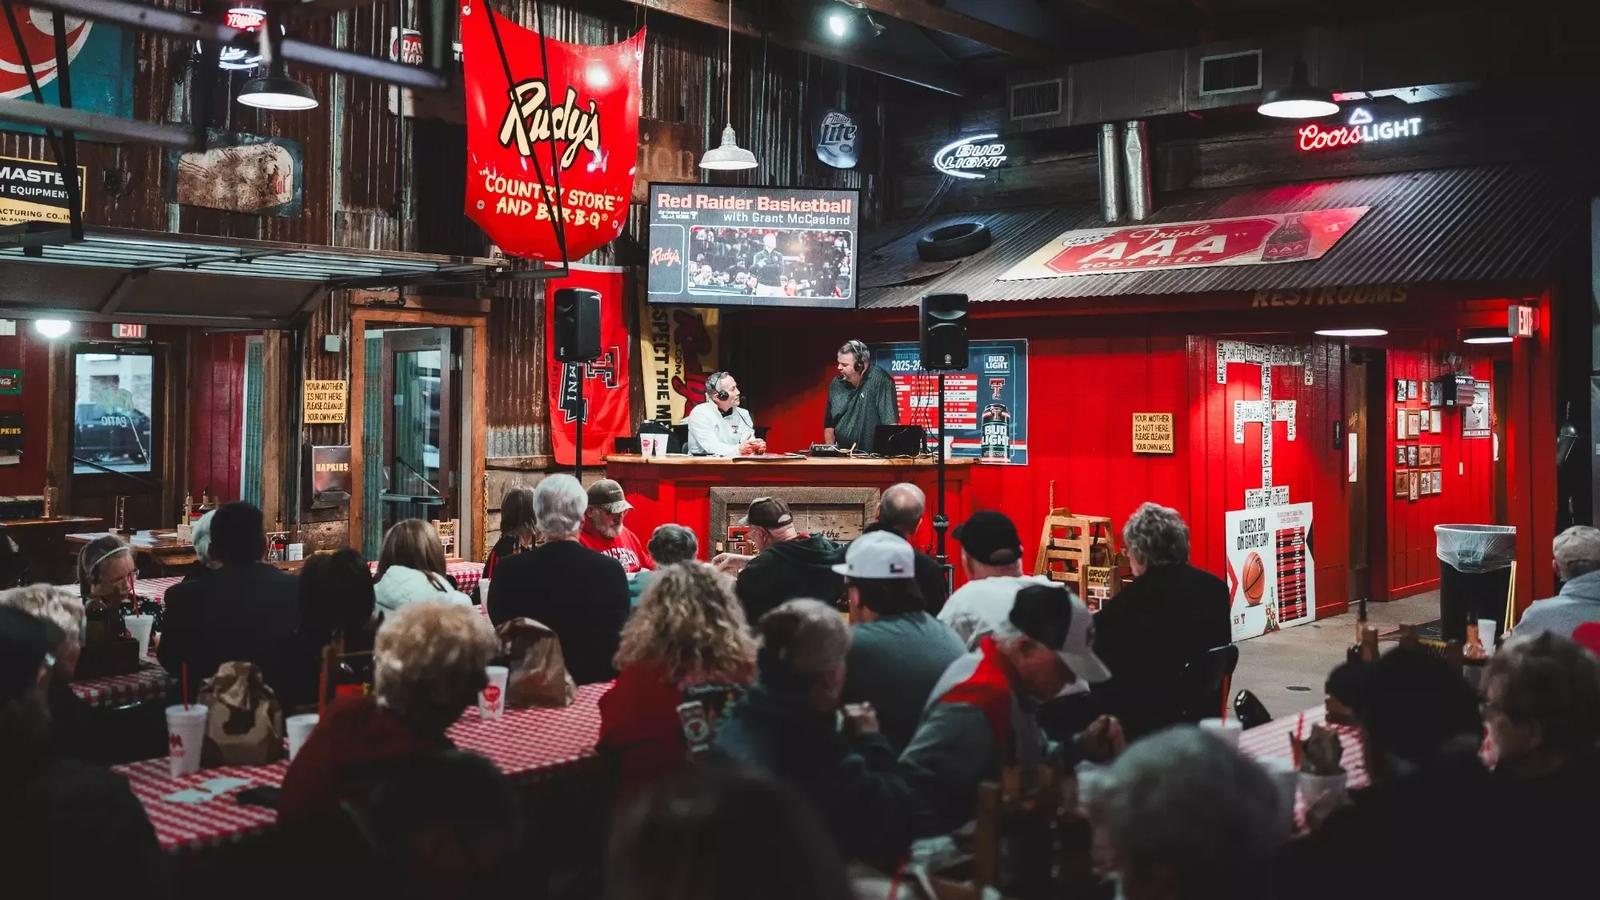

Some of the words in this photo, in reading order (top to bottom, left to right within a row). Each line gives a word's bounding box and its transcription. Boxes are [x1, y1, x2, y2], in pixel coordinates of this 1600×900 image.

[499, 80, 601, 169] Rudy's
[1299, 124, 1363, 151] Coors
[1362, 117, 1422, 142] LIGHT
[955, 144, 1006, 157] BUD
[943, 155, 1008, 169] LIGHT
[496, 196, 533, 217] AND
[657, 193, 692, 209] Red
[696, 194, 753, 210] Raider
[757, 196, 851, 213] Basketball
[723, 212, 749, 223] with
[752, 213, 784, 224] Grant
[787, 214, 850, 225] McCasland
[650, 247, 682, 267] Rudy's
[1146, 255, 1203, 267] BEER
[1251, 286, 1408, 308] RESTROOMS
[119, 323, 143, 337] EXIT
[985, 361, 1009, 369] LIGHT
[306, 382, 319, 391] YOUR
[321, 382, 344, 390] MOTHER
[656, 368, 670, 400] THE
[306, 402, 322, 410] PLEASE
[307, 413, 319, 421] YOUR
[319, 413, 331, 421] OWN
[984, 425, 1008, 435] BUD
[1143, 424, 1154, 432] NOT
[315, 463, 349, 472] NAPKINS
[1239, 519, 1257, 534] WRECK
[826, 529, 841, 539] the
[1237, 536, 1244, 551] ON
[1245, 535, 1259, 549] GAME
[1260, 533, 1269, 546] DAY
